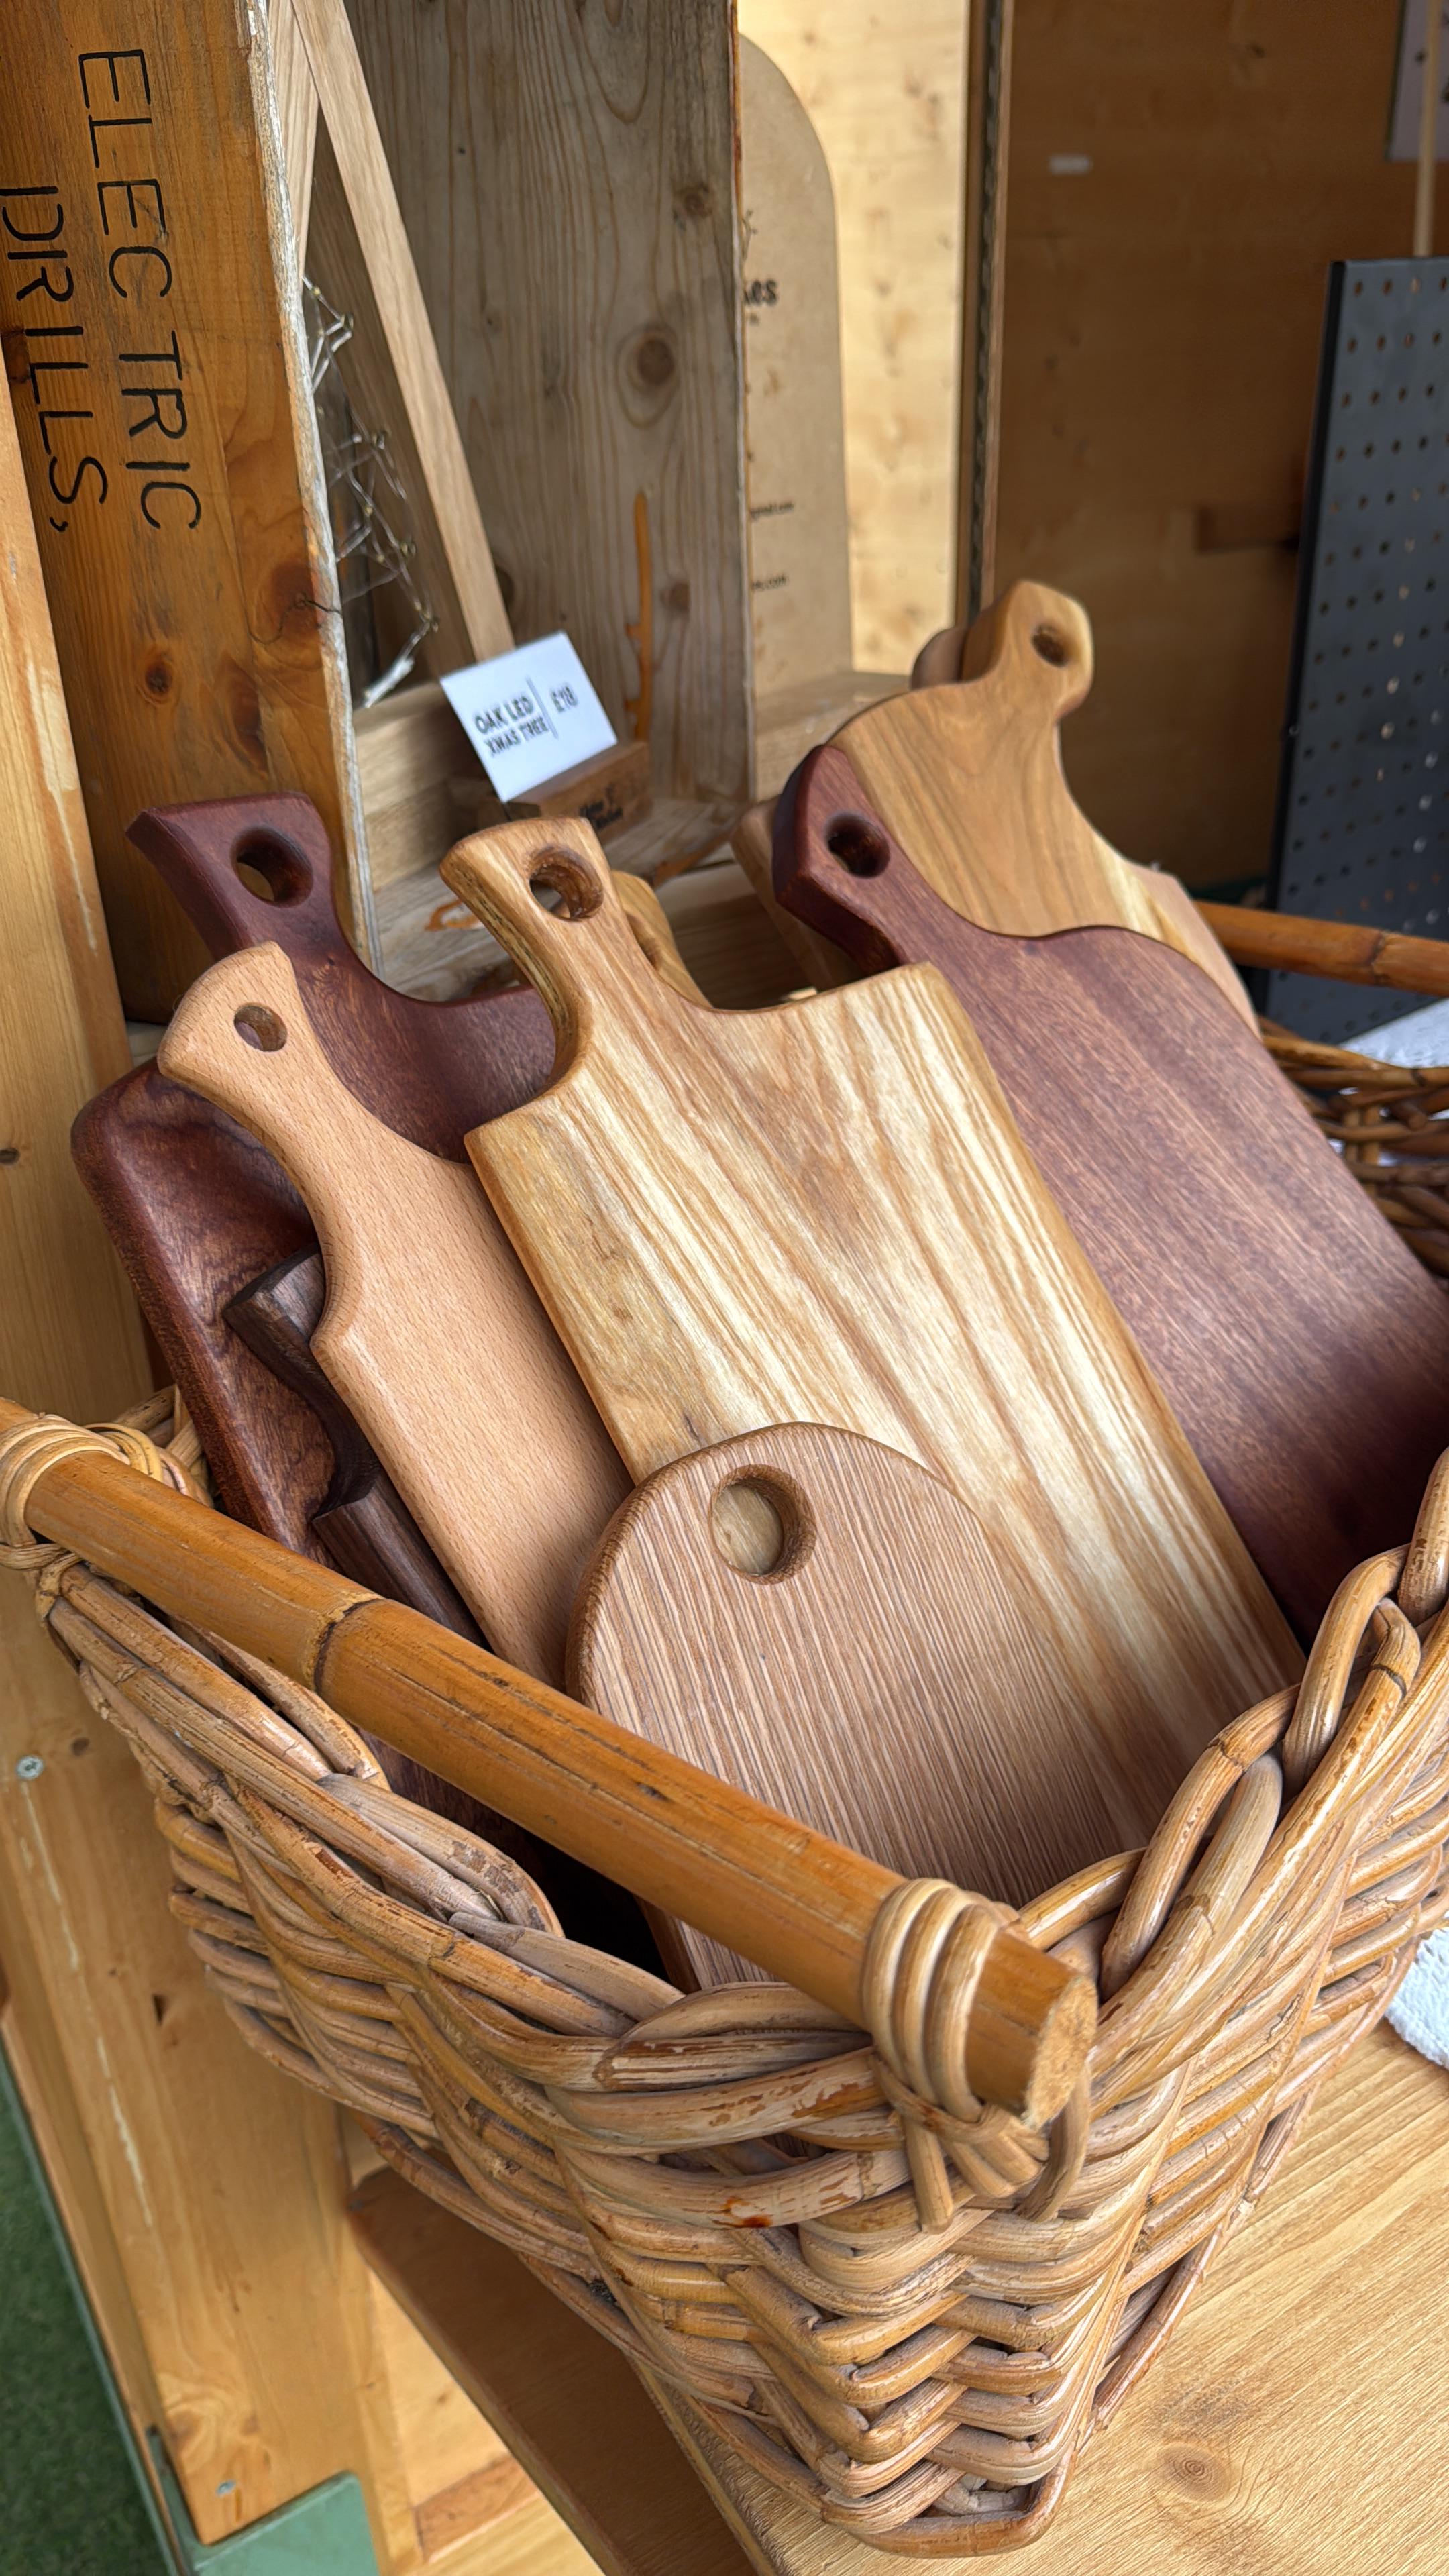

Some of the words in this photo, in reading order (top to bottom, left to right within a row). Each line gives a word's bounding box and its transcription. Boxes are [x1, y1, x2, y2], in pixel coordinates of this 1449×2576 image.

[474, 706, 508, 735] OAK
[504, 696, 534, 721] LED
[485, 729, 521, 756] XMAS
[518, 716, 549, 741] TREE
